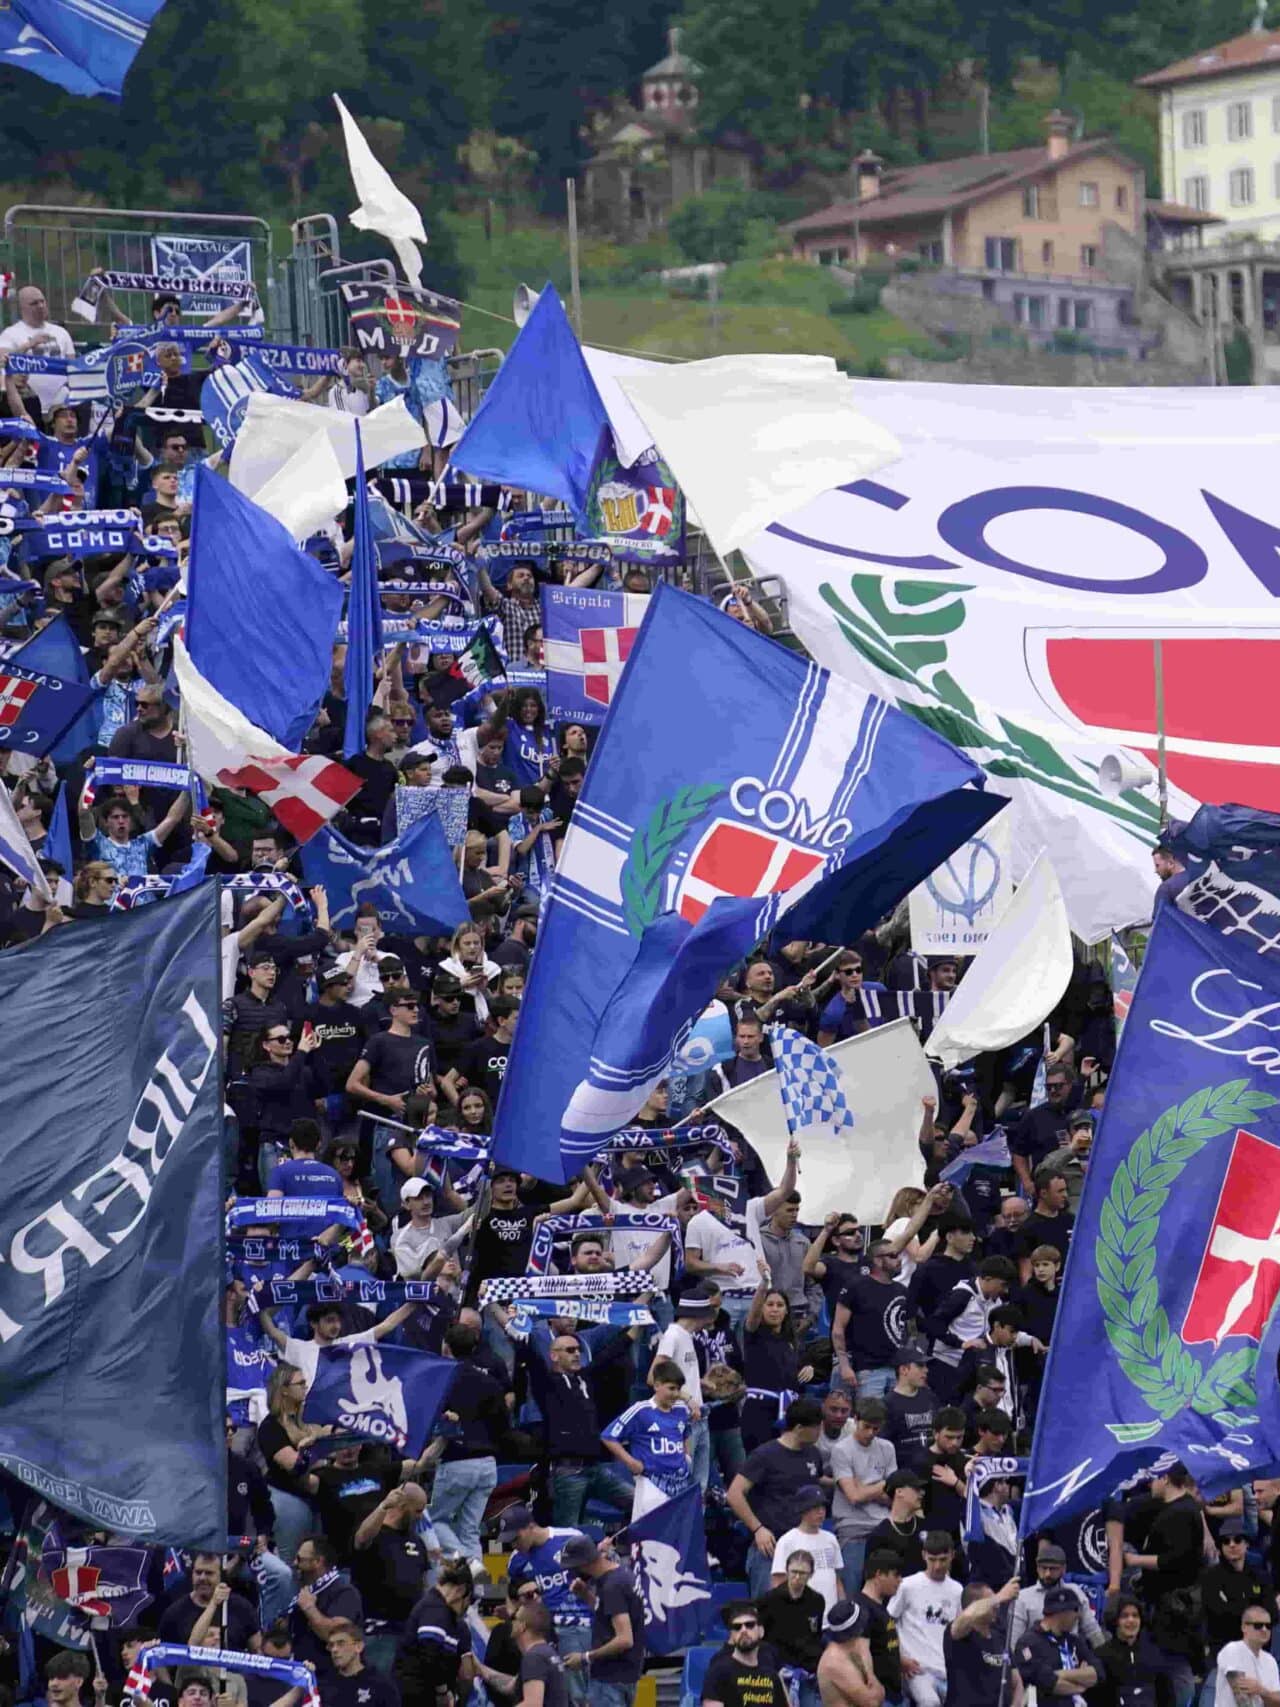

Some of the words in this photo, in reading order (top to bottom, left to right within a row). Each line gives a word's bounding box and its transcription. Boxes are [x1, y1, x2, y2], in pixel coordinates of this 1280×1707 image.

[106, 272, 156, 289] LET'S
[157, 276, 185, 291] GO
[188, 279, 243, 298] BLUES
[48, 531, 124, 549] COMO
[551, 590, 612, 610] Brigata
[520, 746, 551, 764] Ube
[728, 776, 853, 848] COMO
[315, 1022, 356, 1048] Carlsberg
[488, 1056, 508, 1068] CO
[612, 1129, 654, 1148] RVA
[490, 1217, 528, 1231] COMO
[498, 1230, 521, 1241] 1907
[535, 1214, 593, 1258] CURVA
[270, 1280, 432, 1304] COMO
[650, 1436, 684, 1456] Ube
